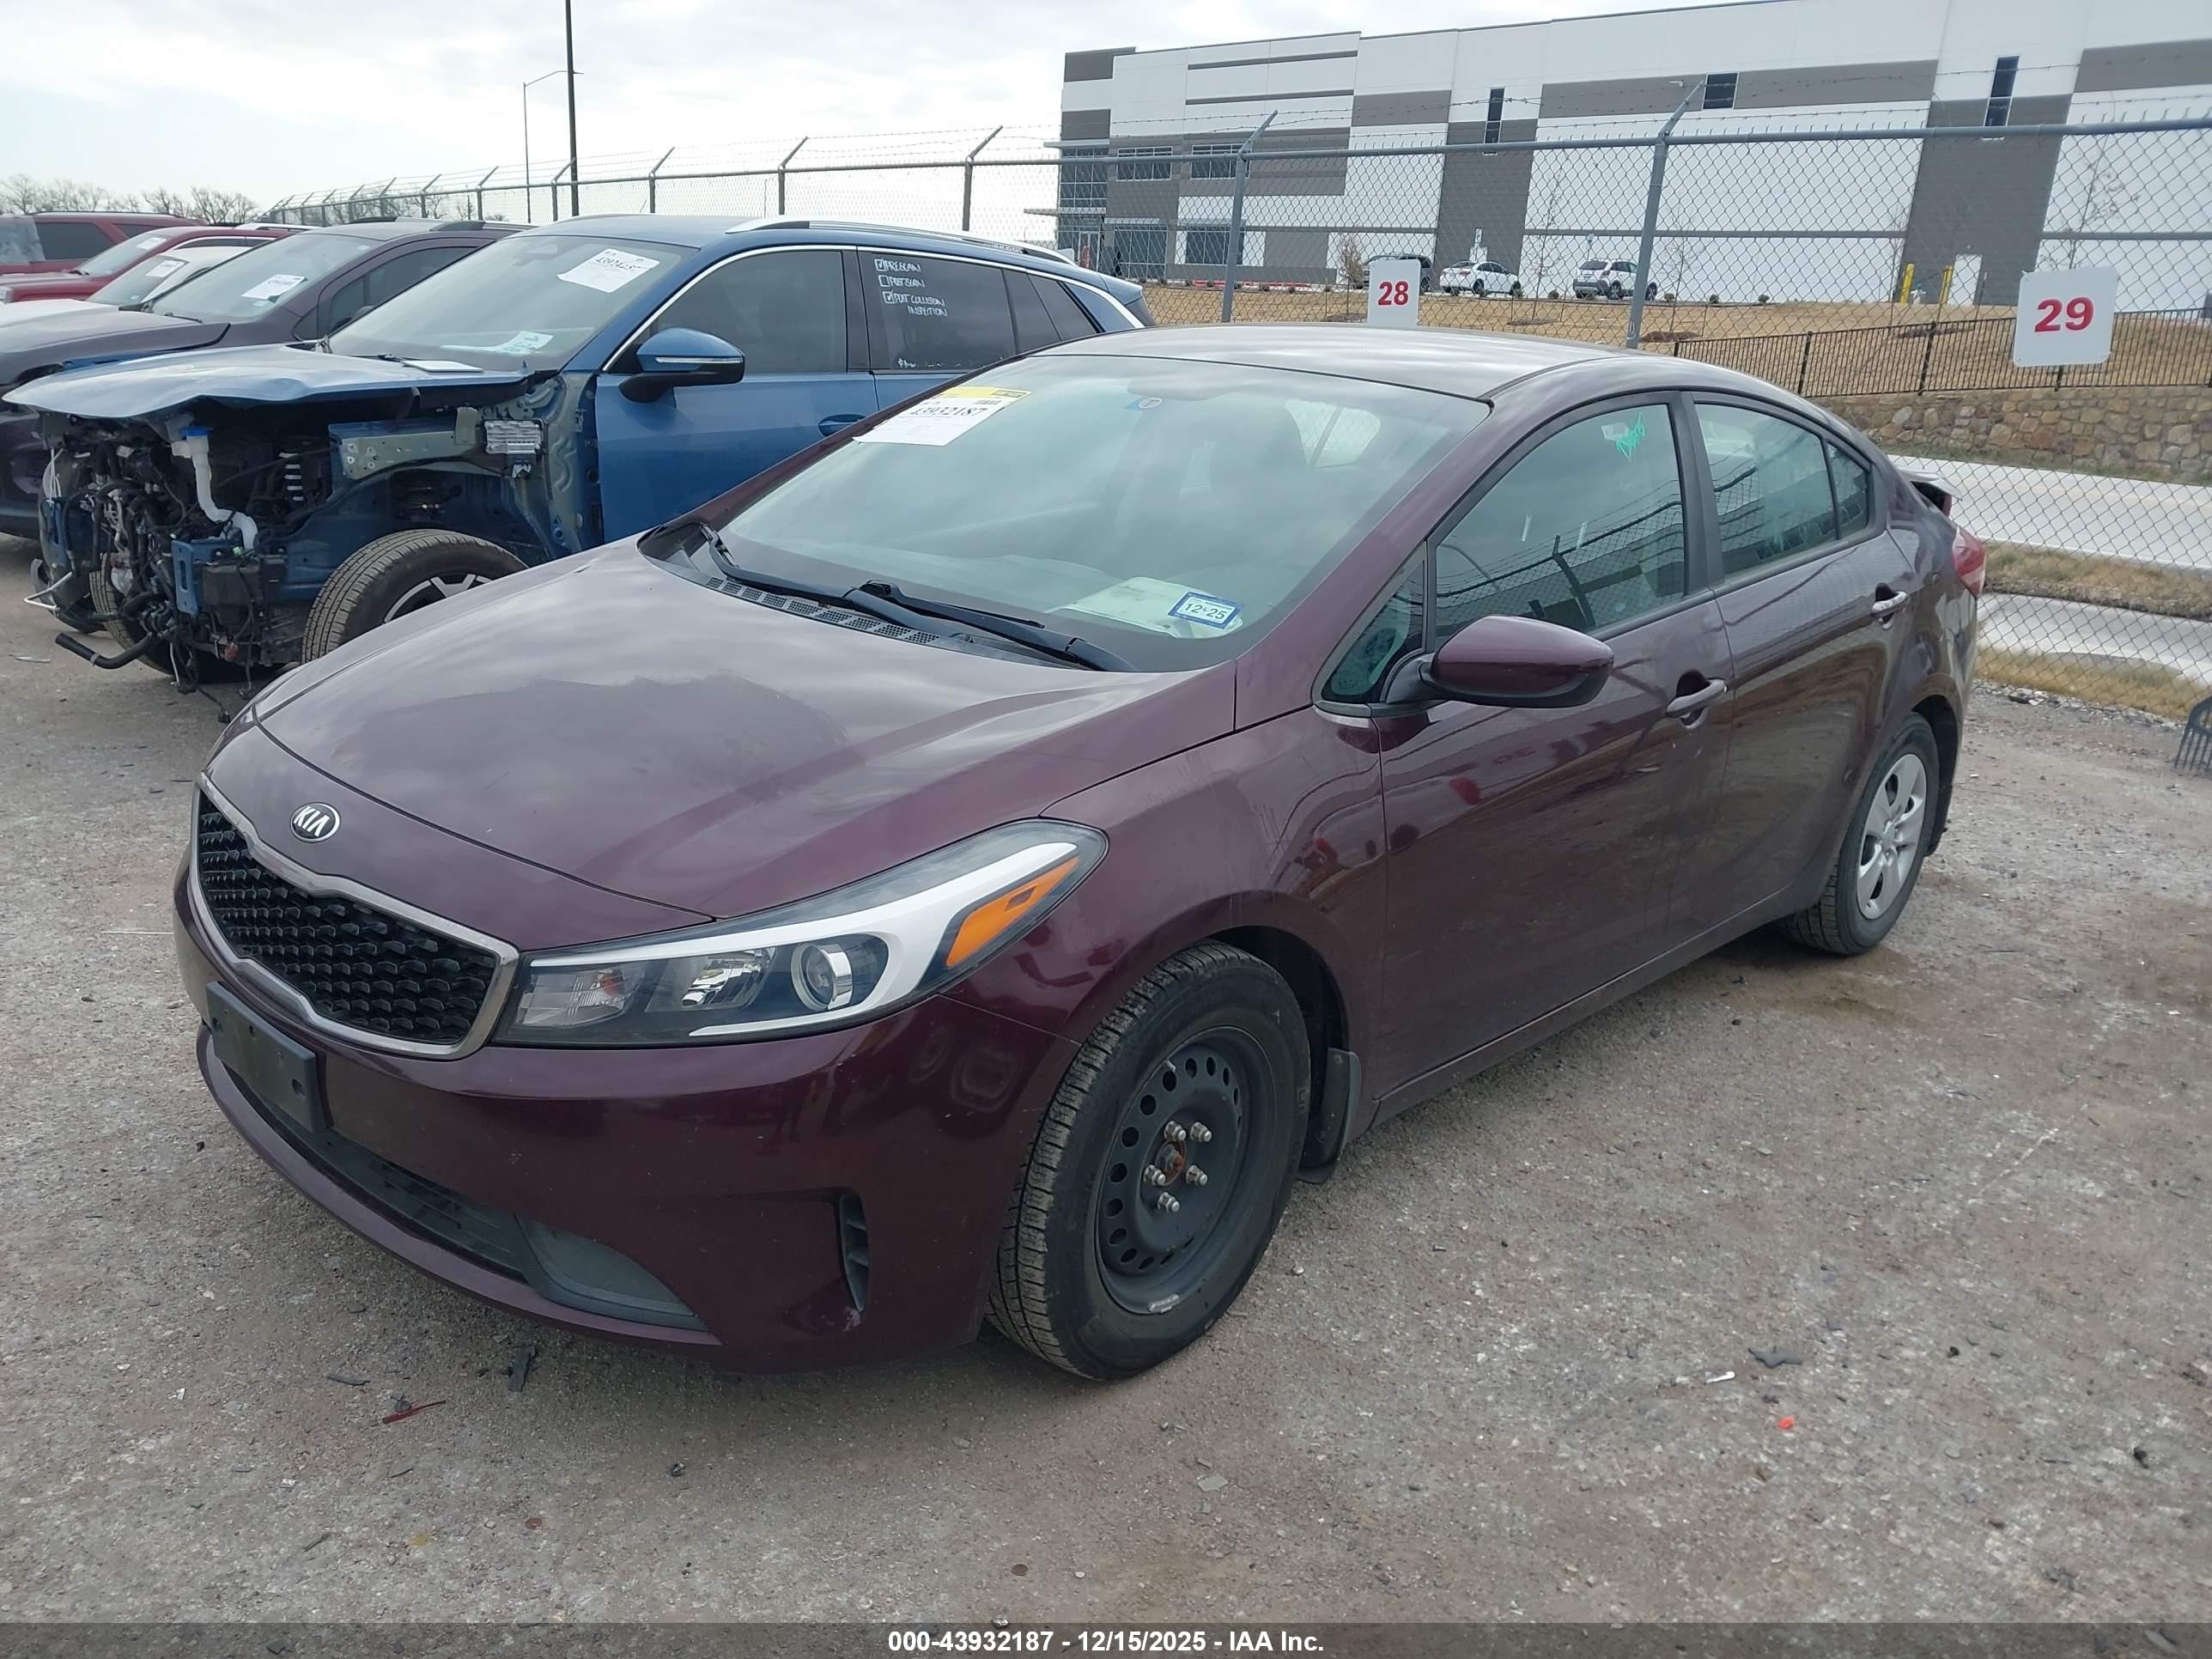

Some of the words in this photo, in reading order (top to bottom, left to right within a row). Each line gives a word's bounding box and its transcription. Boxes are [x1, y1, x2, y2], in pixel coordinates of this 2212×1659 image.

[1377, 281, 1409, 306] 28
[2034, 296, 2094, 333] 29
[1185, 603, 1203, 614] 12
[1206, 608, 1227, 620] 25
[293, 805, 331, 837] KIA
